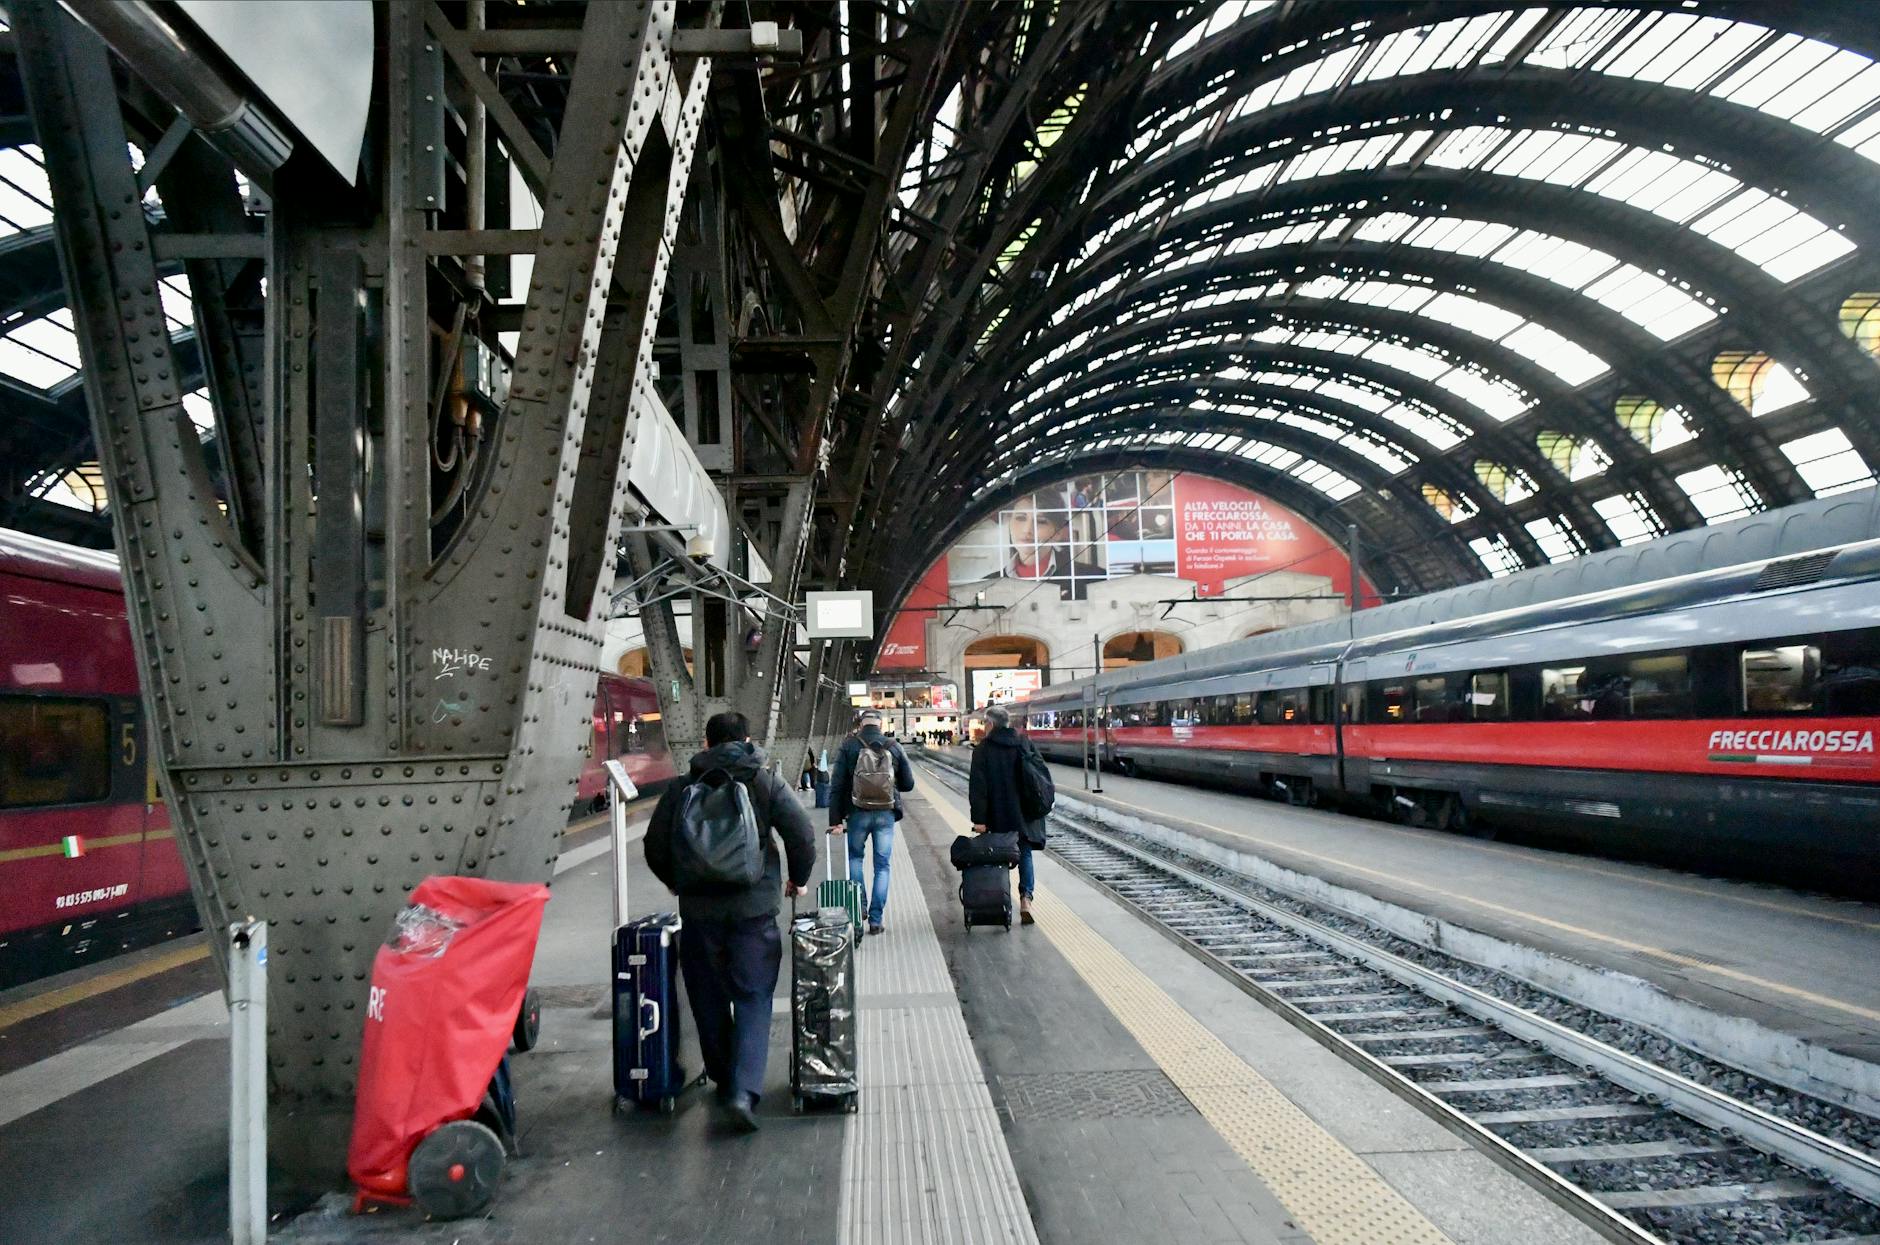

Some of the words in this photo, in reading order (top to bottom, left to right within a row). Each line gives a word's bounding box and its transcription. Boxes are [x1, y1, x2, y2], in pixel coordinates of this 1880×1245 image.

[1184, 501, 1209, 511] ALTA
[1211, 500, 1261, 511] VELOCITÀ
[1184, 511, 1191, 521] E
[1185, 522, 1199, 531] DA
[1202, 522, 1213, 531] 10
[1246, 521, 1260, 530] LA
[1262, 521, 1292, 530] CASA
[1185, 531, 1206, 541] CHE
[1209, 531, 1219, 541] TI
[1221, 531, 1254, 541] PORTA
[1256, 531, 1265, 541] A
[122, 722, 136, 766] 5
[1708, 730, 1874, 752] FRECCIAROSSA
[367, 985, 387, 1022] RE
